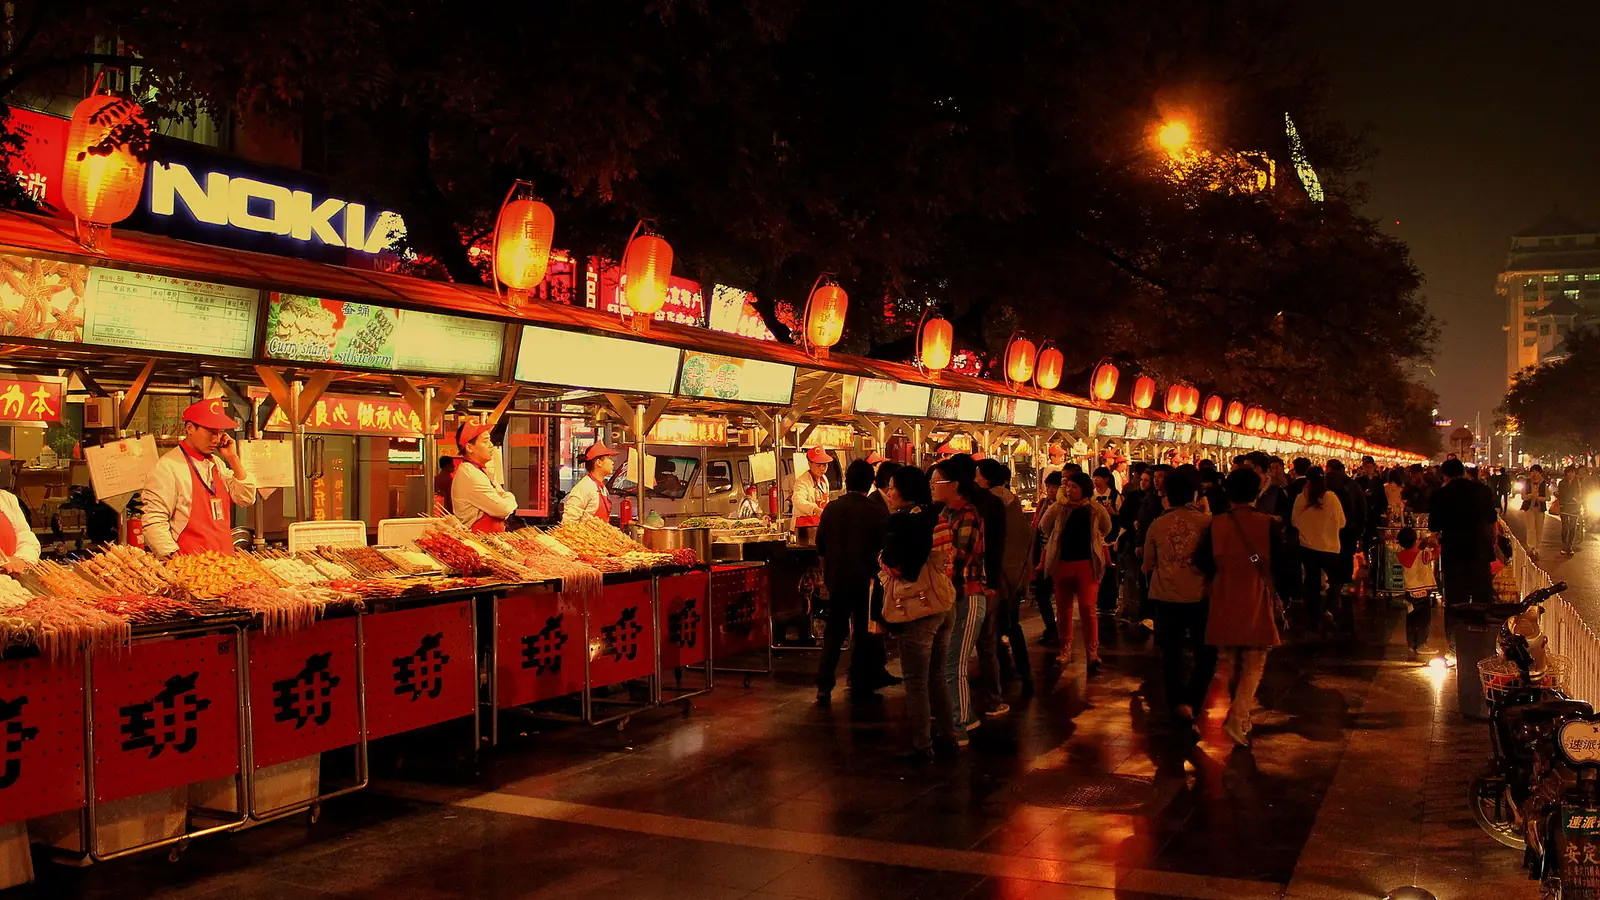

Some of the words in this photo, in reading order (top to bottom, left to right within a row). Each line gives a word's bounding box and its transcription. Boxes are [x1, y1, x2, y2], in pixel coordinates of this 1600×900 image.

[151, 160, 412, 257] NOKIA
[342, 302, 370, 317] 蚕蛹
[269, 337, 298, 358] Curry
[336, 349, 392, 365] silkworm
[1568, 738, 1600, 751] 速派
[1566, 815, 1600, 828] 速派
